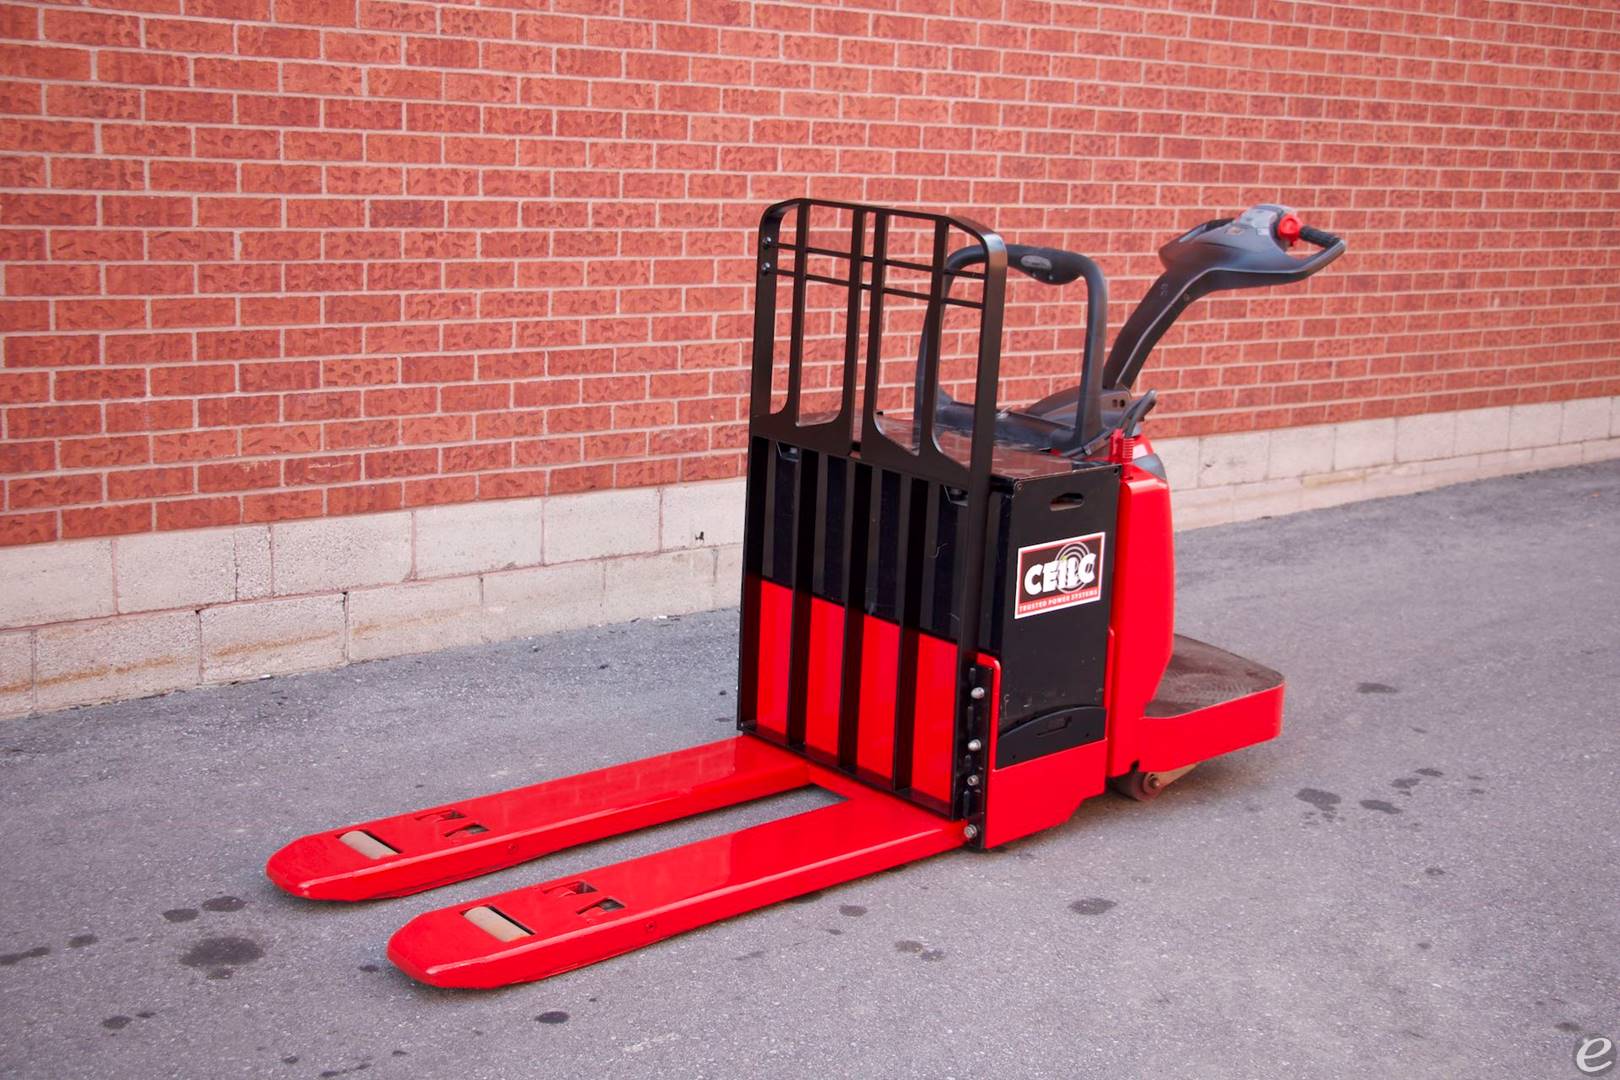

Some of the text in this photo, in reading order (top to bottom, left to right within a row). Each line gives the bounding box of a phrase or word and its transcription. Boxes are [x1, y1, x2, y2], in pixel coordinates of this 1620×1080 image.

[1019, 589, 1098, 612] TRUSTED POWER SYSTEMS
